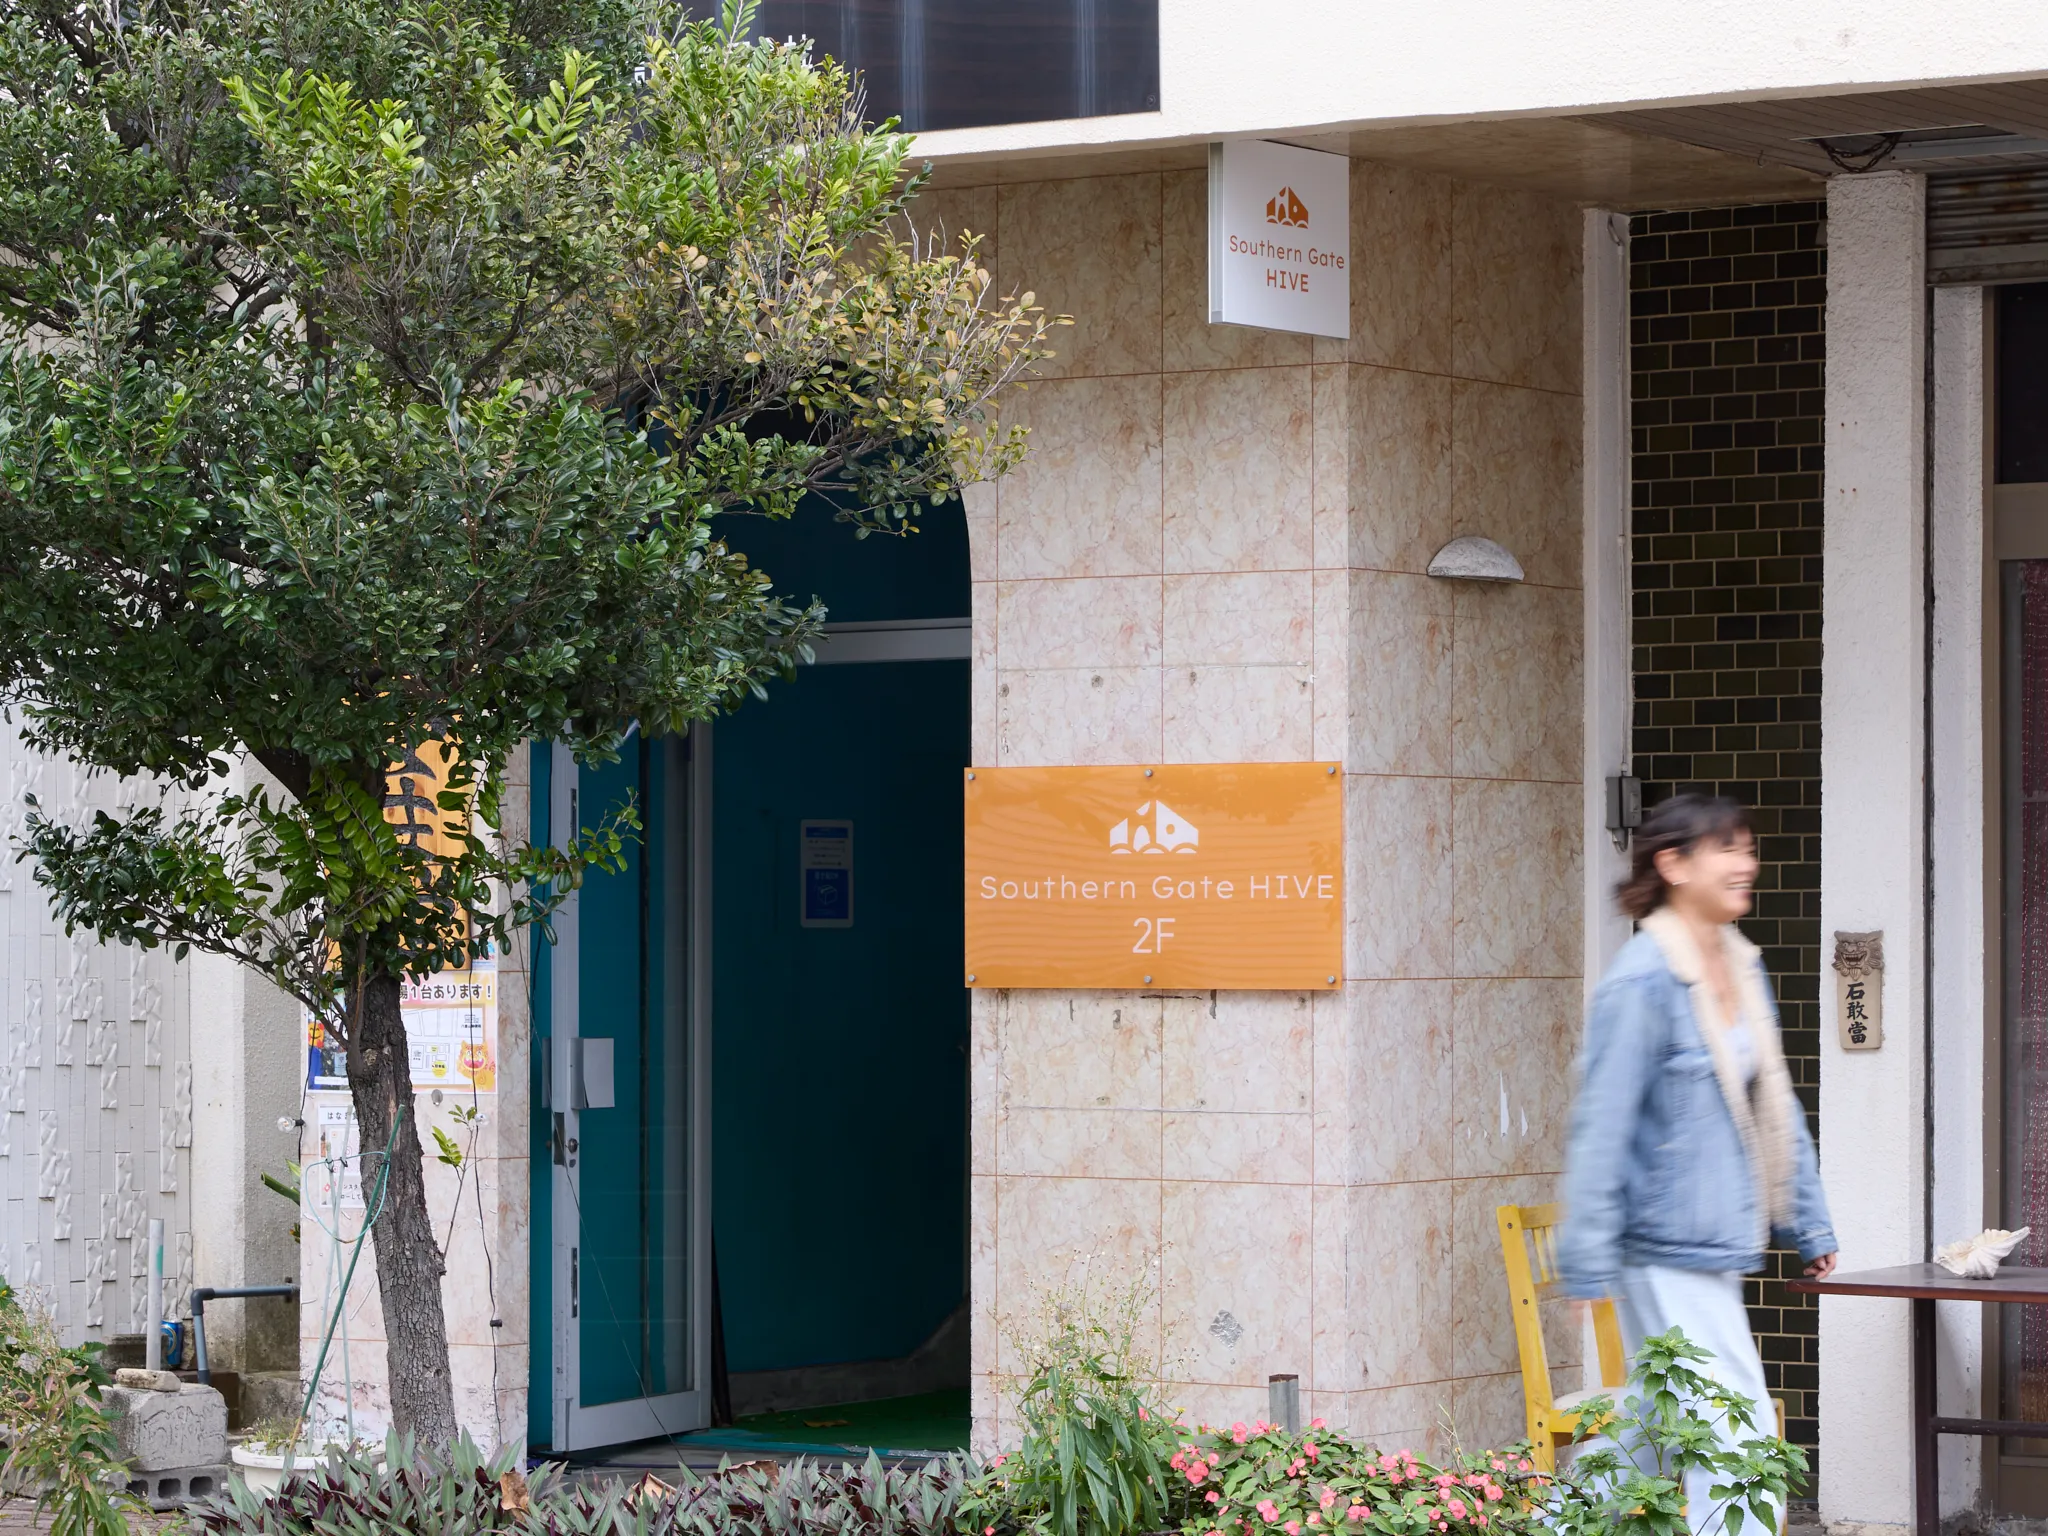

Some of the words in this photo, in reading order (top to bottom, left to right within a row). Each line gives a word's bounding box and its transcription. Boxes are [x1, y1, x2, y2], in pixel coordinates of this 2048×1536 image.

[1229, 235, 1302, 263] Southern
[1308, 248, 1345, 269] Gate
[1266, 268, 1309, 292] HIVE
[980, 875, 1136, 899] Southern
[1151, 875, 1234, 899] Gate
[1250, 875, 1334, 899] HIVE
[1132, 917, 1176, 954] 2F
[1845, 981, 1869, 1044] 石敢當
